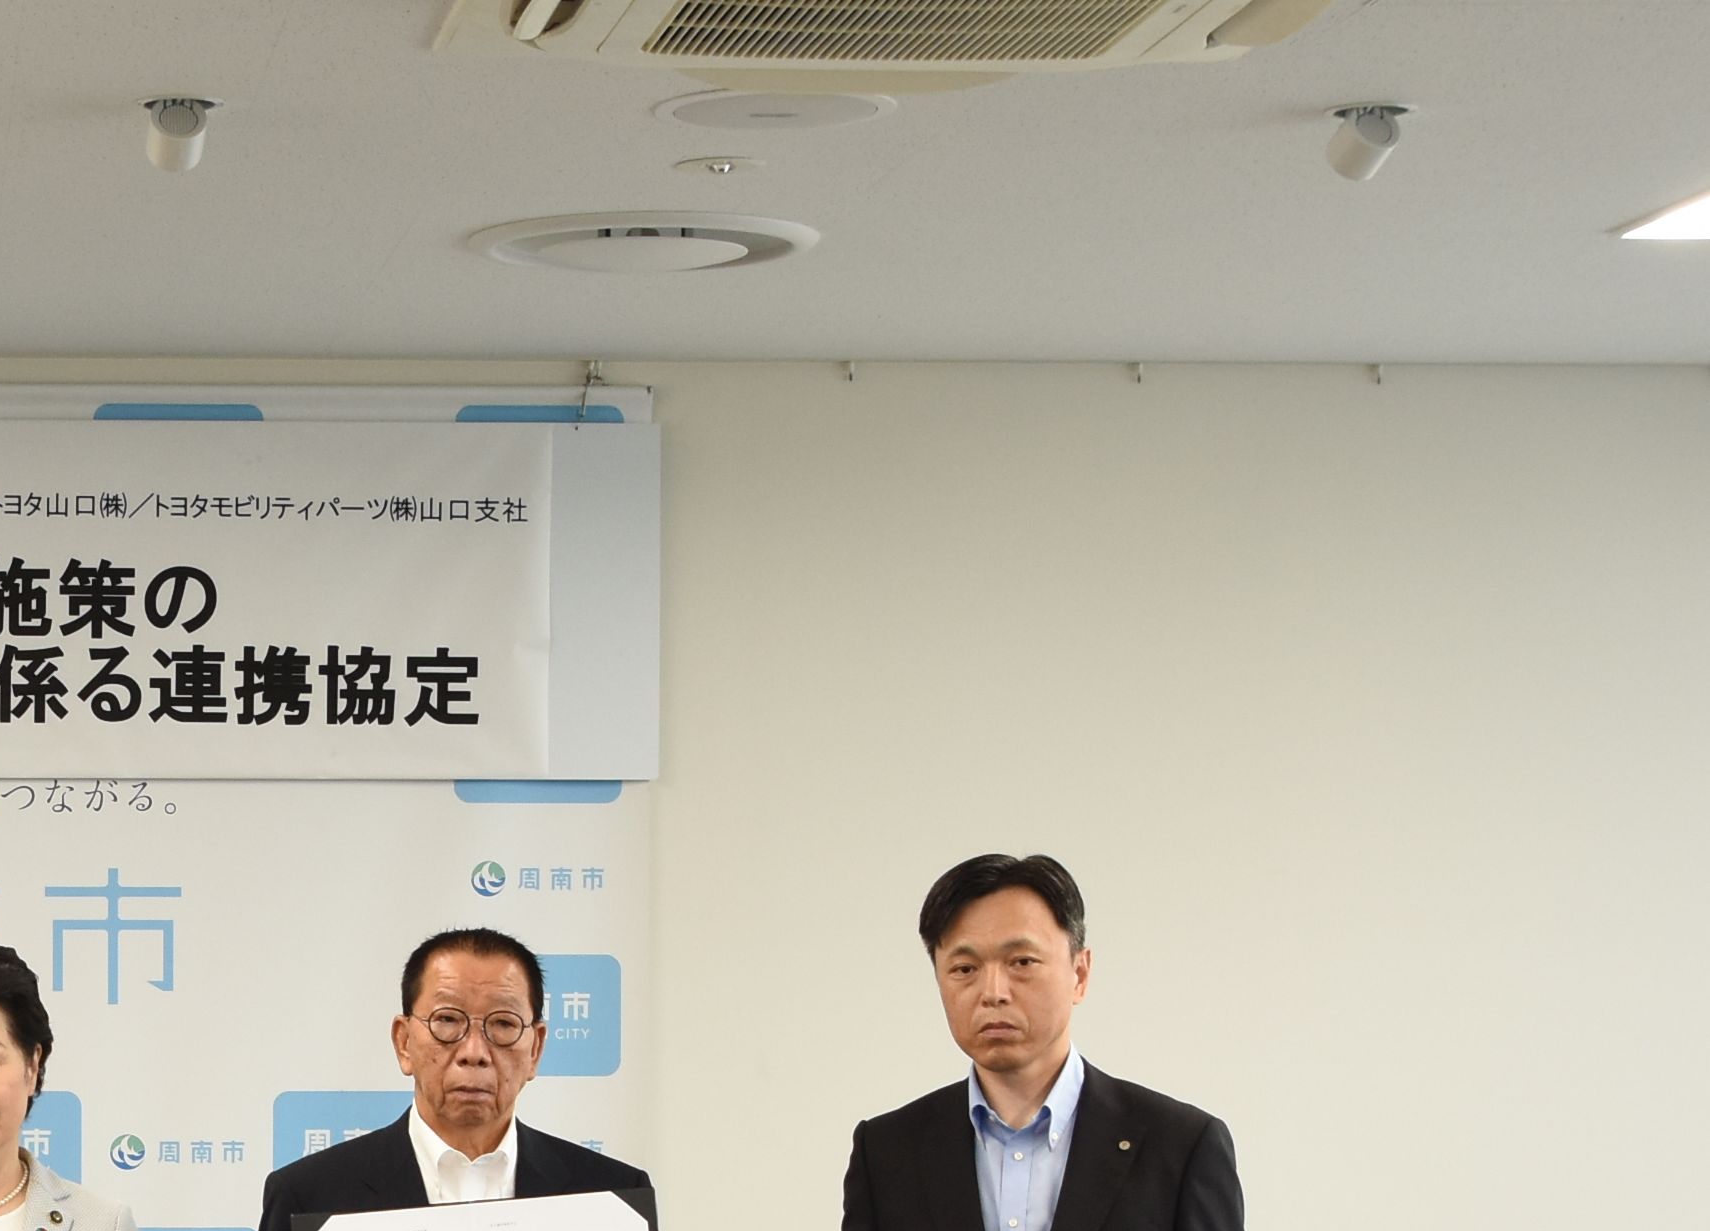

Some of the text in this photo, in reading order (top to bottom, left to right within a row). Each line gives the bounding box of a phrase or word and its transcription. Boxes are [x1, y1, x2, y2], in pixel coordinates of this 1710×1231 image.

[518, 867, 604, 890] 周南市
[555, 1028, 590, 1039] CITY
[158, 1140, 245, 1164] 周南市
